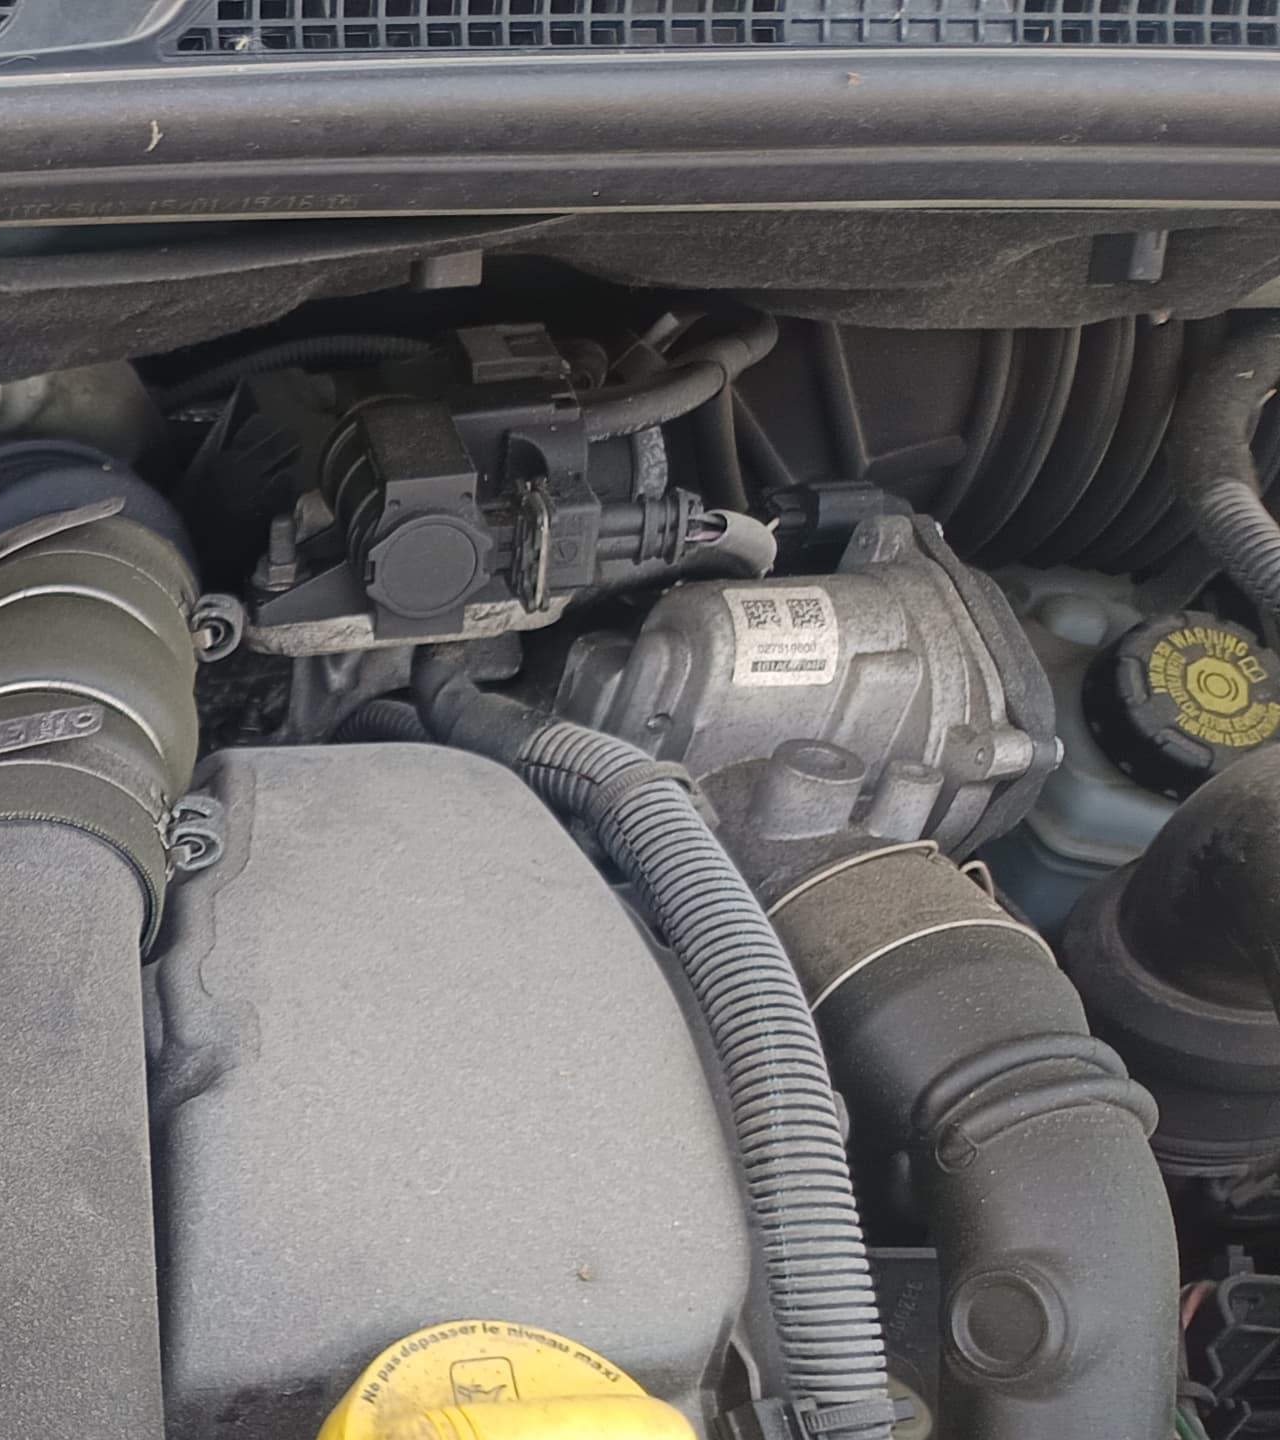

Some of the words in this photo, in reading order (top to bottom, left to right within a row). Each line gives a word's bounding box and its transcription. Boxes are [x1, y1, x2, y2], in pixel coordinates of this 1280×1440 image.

[377, 1355, 401, 1384] pas
[481, 1321, 500, 1335] le
[507, 1325, 571, 1353] niveau
[572, 1349, 621, 1384] maxi
